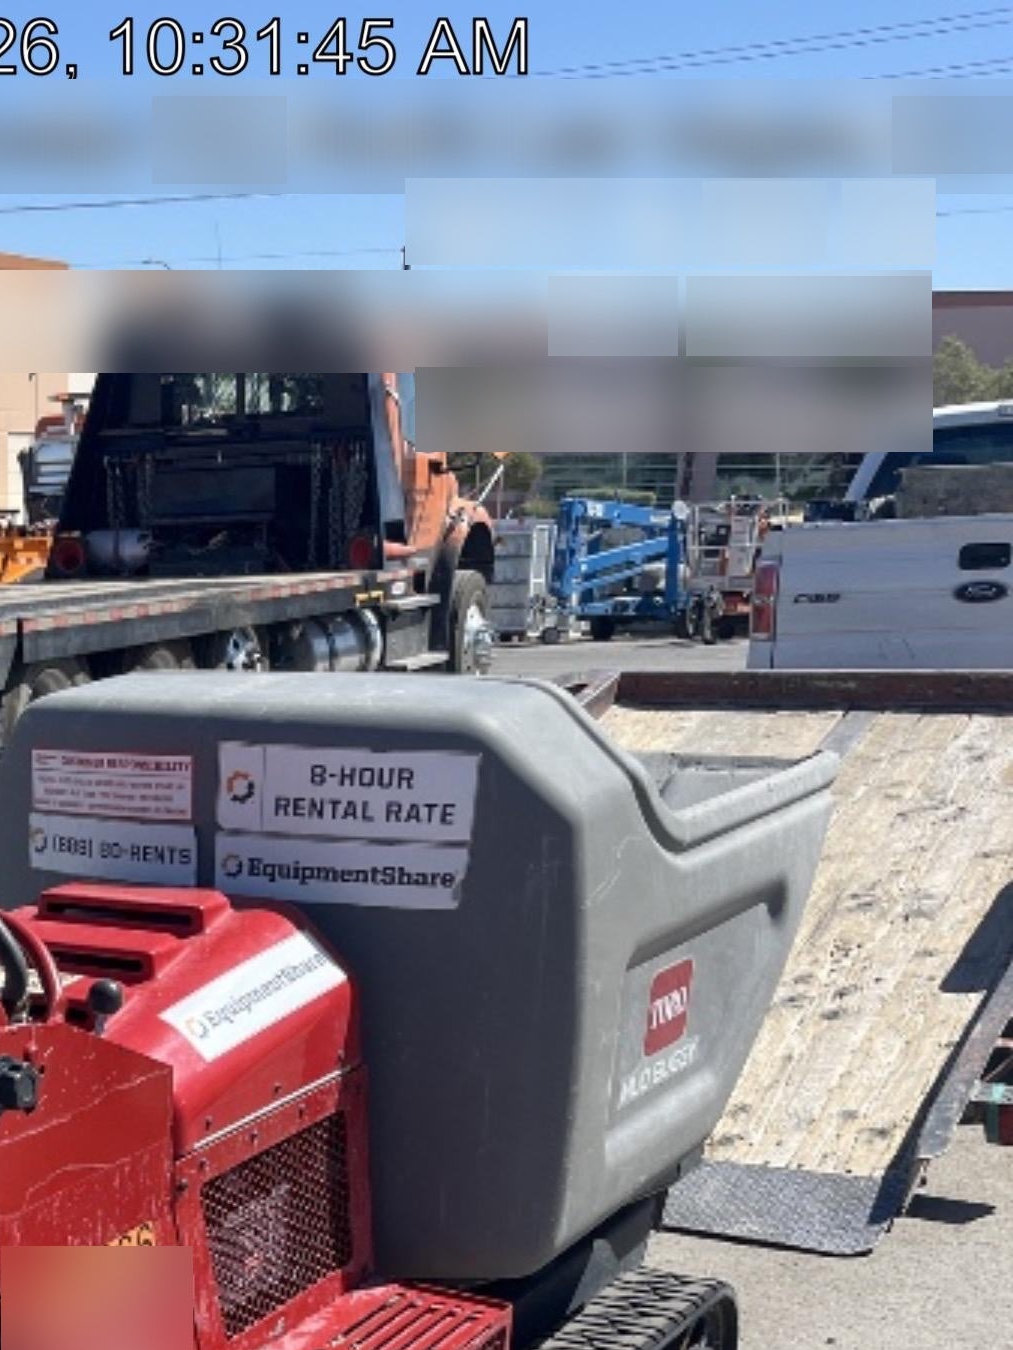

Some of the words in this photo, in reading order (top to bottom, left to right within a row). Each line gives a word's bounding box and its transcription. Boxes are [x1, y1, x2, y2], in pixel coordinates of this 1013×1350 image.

[310, 764, 414, 790] 8-HOUR
[274, 797, 375, 823] RENTAL
[385, 801, 457, 825] RATE
[247, 857, 456, 888] EquipmentShare
